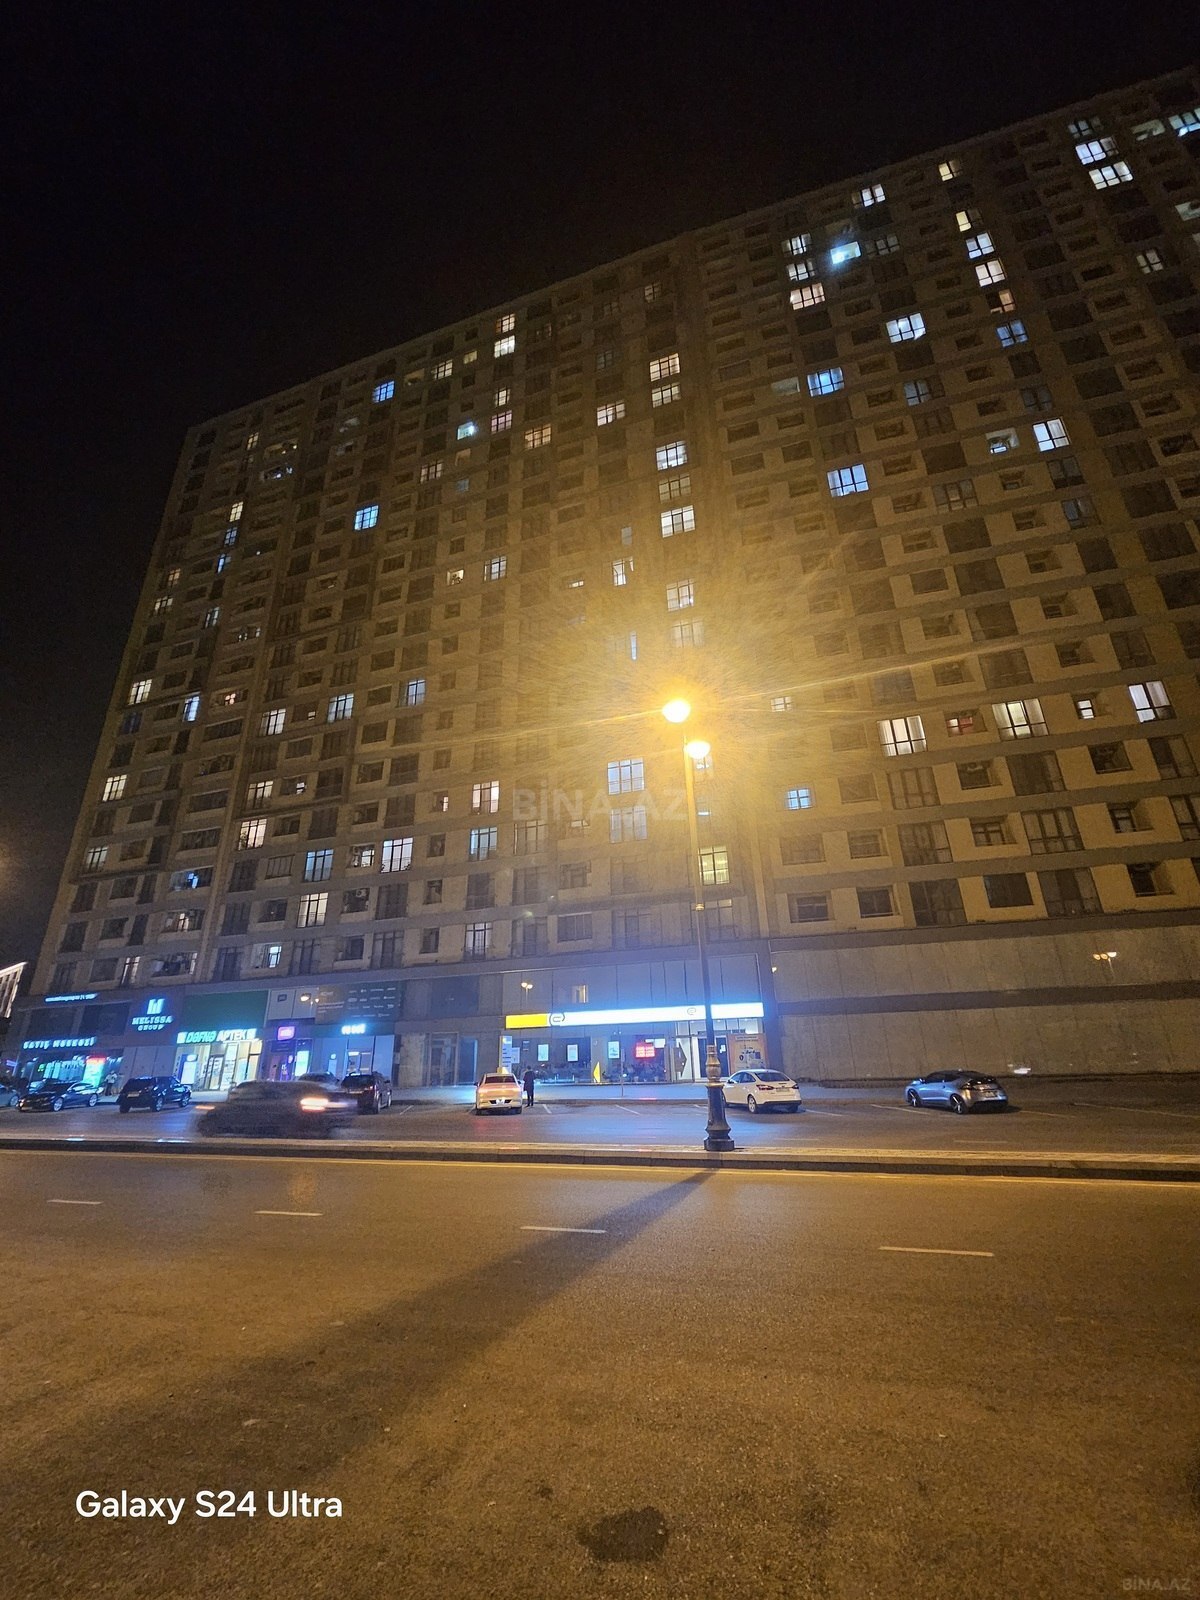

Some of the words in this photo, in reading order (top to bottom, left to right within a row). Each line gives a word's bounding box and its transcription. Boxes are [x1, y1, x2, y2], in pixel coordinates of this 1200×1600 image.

[132, 1015, 173, 1025] MELISSA
[137, 1024, 165, 1032] GROUP
[216, 1028, 248, 1042] APTEK
